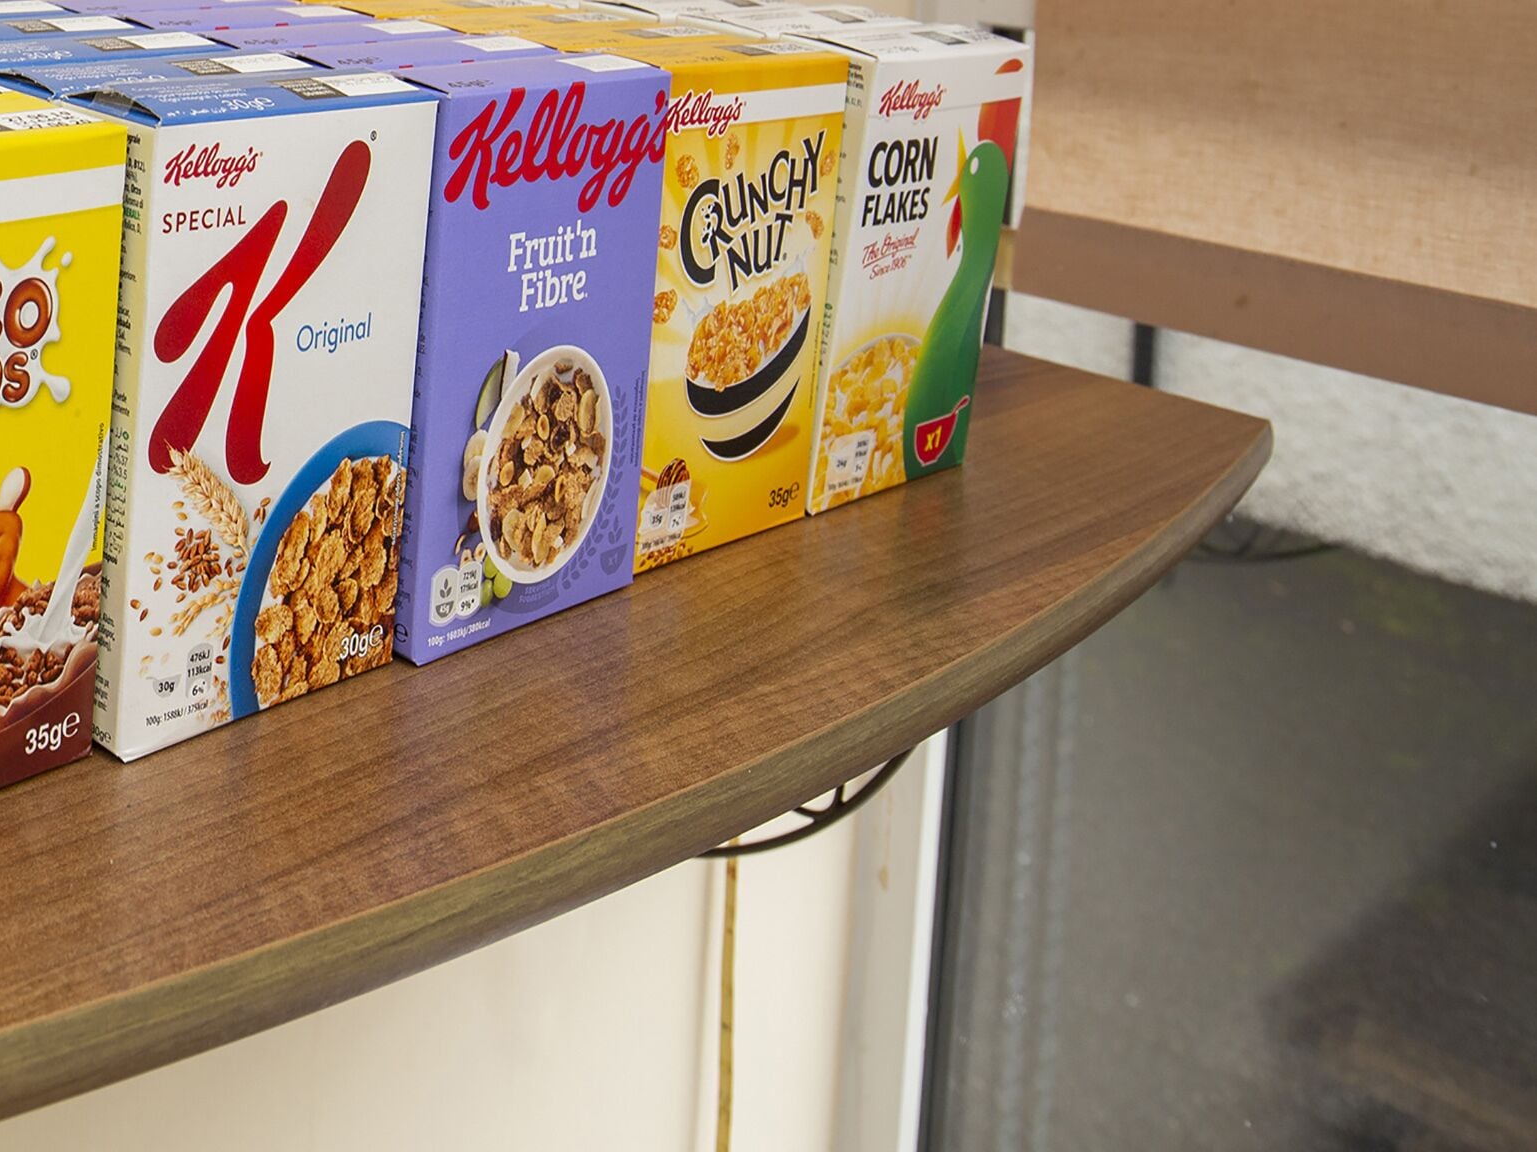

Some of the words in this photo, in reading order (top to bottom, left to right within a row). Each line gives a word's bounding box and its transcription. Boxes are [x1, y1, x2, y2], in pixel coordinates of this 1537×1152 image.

[667, 90, 744, 137] Kellogg's
[879, 79, 943, 120] Kellogg's
[164, 141, 261, 189] Kellogg's
[443, 80, 671, 214] Kellogg's
[867, 135, 939, 188] CORN
[162, 205, 248, 235] SPECIAL
[861, 186, 931, 228] FLAKES
[507, 219, 598, 274] Fruit'n
[727, 212, 793, 291] NUT
[862, 240, 880, 265] The
[880, 227, 920, 259] Original
[148, 139, 374, 487] K
[295, 311, 374, 355] Original
[157, 681, 176, 694] 30g
